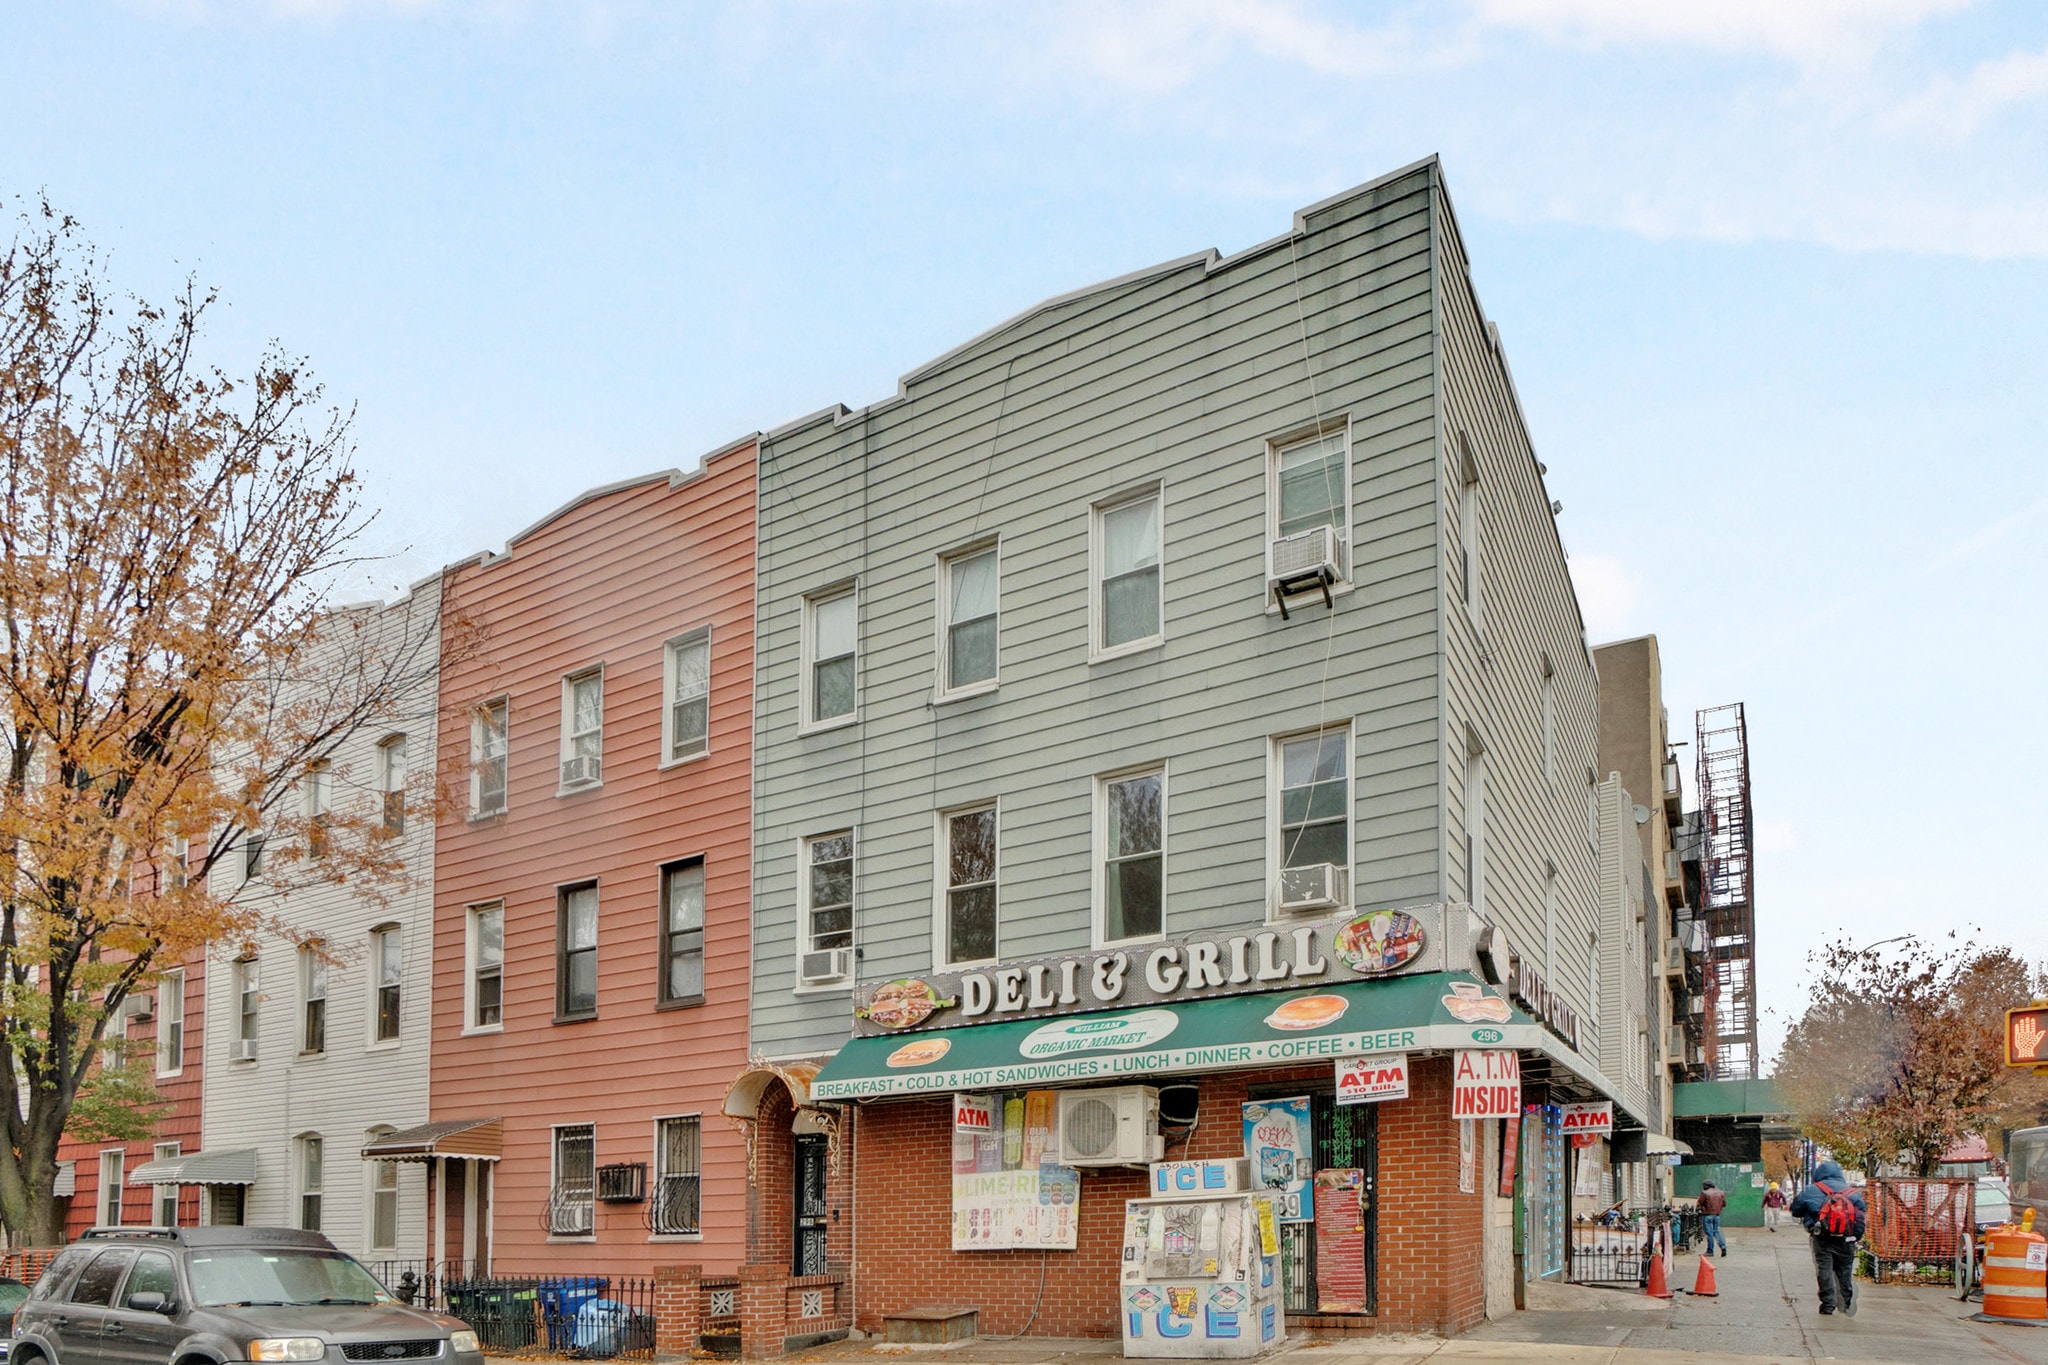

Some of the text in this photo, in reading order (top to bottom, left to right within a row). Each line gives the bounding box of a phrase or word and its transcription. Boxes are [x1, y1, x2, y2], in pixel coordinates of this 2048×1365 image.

[961, 926, 1327, 1016] DELI & GRILL
[1074, 1021, 1122, 1033] WILLIAM
[1477, 1030, 1499, 1042] 296
[1029, 1031, 1147, 1055] ORGANIC MARKET
[817, 1031, 1416, 1097] BREAKFAST COLD & HOT SANDWICHES LUNCH DINNER COFFEE BEER
[1339, 1067, 1404, 1088] ATM
[1347, 1084, 1397, 1094] $10 Bills
[1454, 1086, 1519, 1115] INSIDE
[957, 1108, 989, 1127] ATM
[1563, 1112, 1609, 1127] ATM
[1029, 1127, 1048, 1135] BUD
[1157, 1165, 1227, 1191] ICE
[1128, 1304, 1241, 1338] ICE
